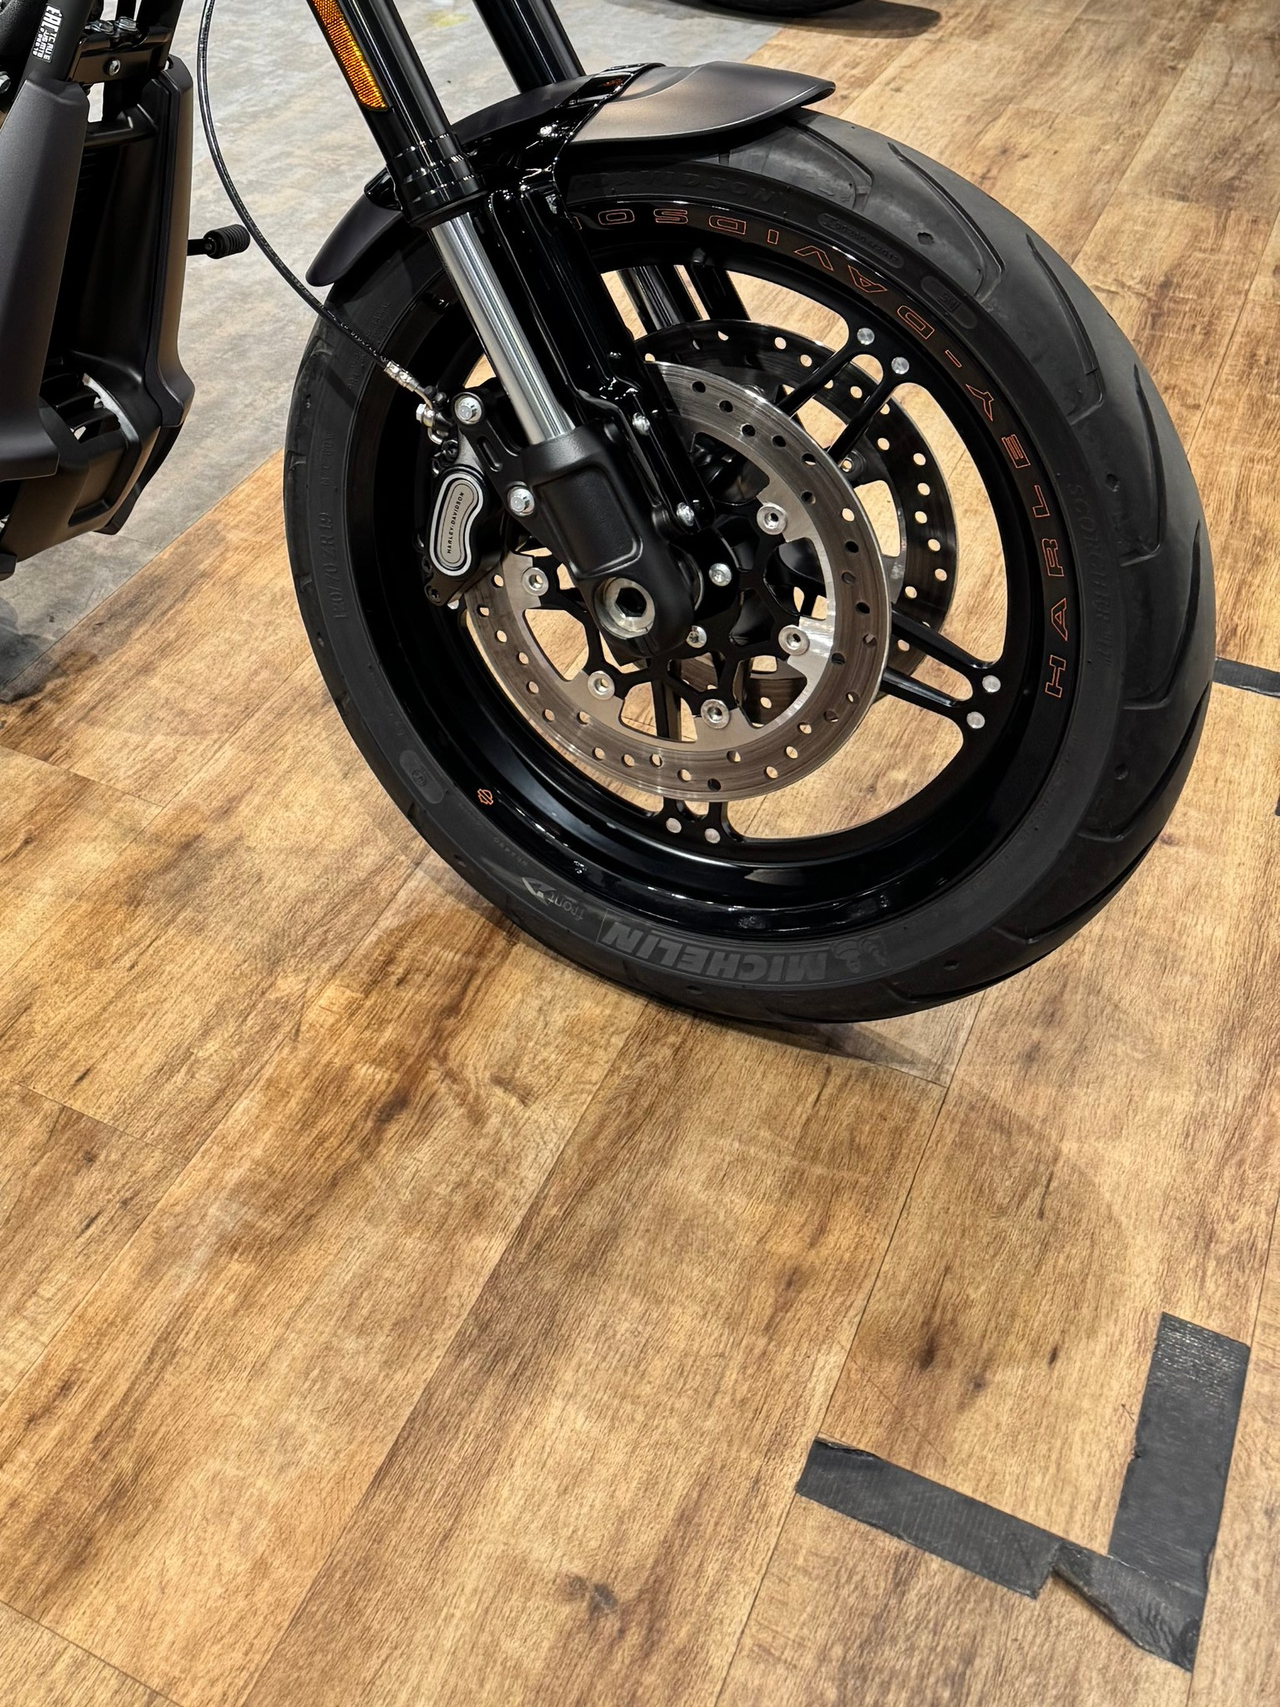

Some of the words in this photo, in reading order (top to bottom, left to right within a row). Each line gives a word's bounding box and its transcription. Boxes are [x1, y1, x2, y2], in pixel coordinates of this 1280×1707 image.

[573, 208, 1069, 699] HARLEY-DAVIDSO
[447, 492, 465, 554] HARLEY-DAVIDSON
[600, 920, 829, 985] MICHELIN
